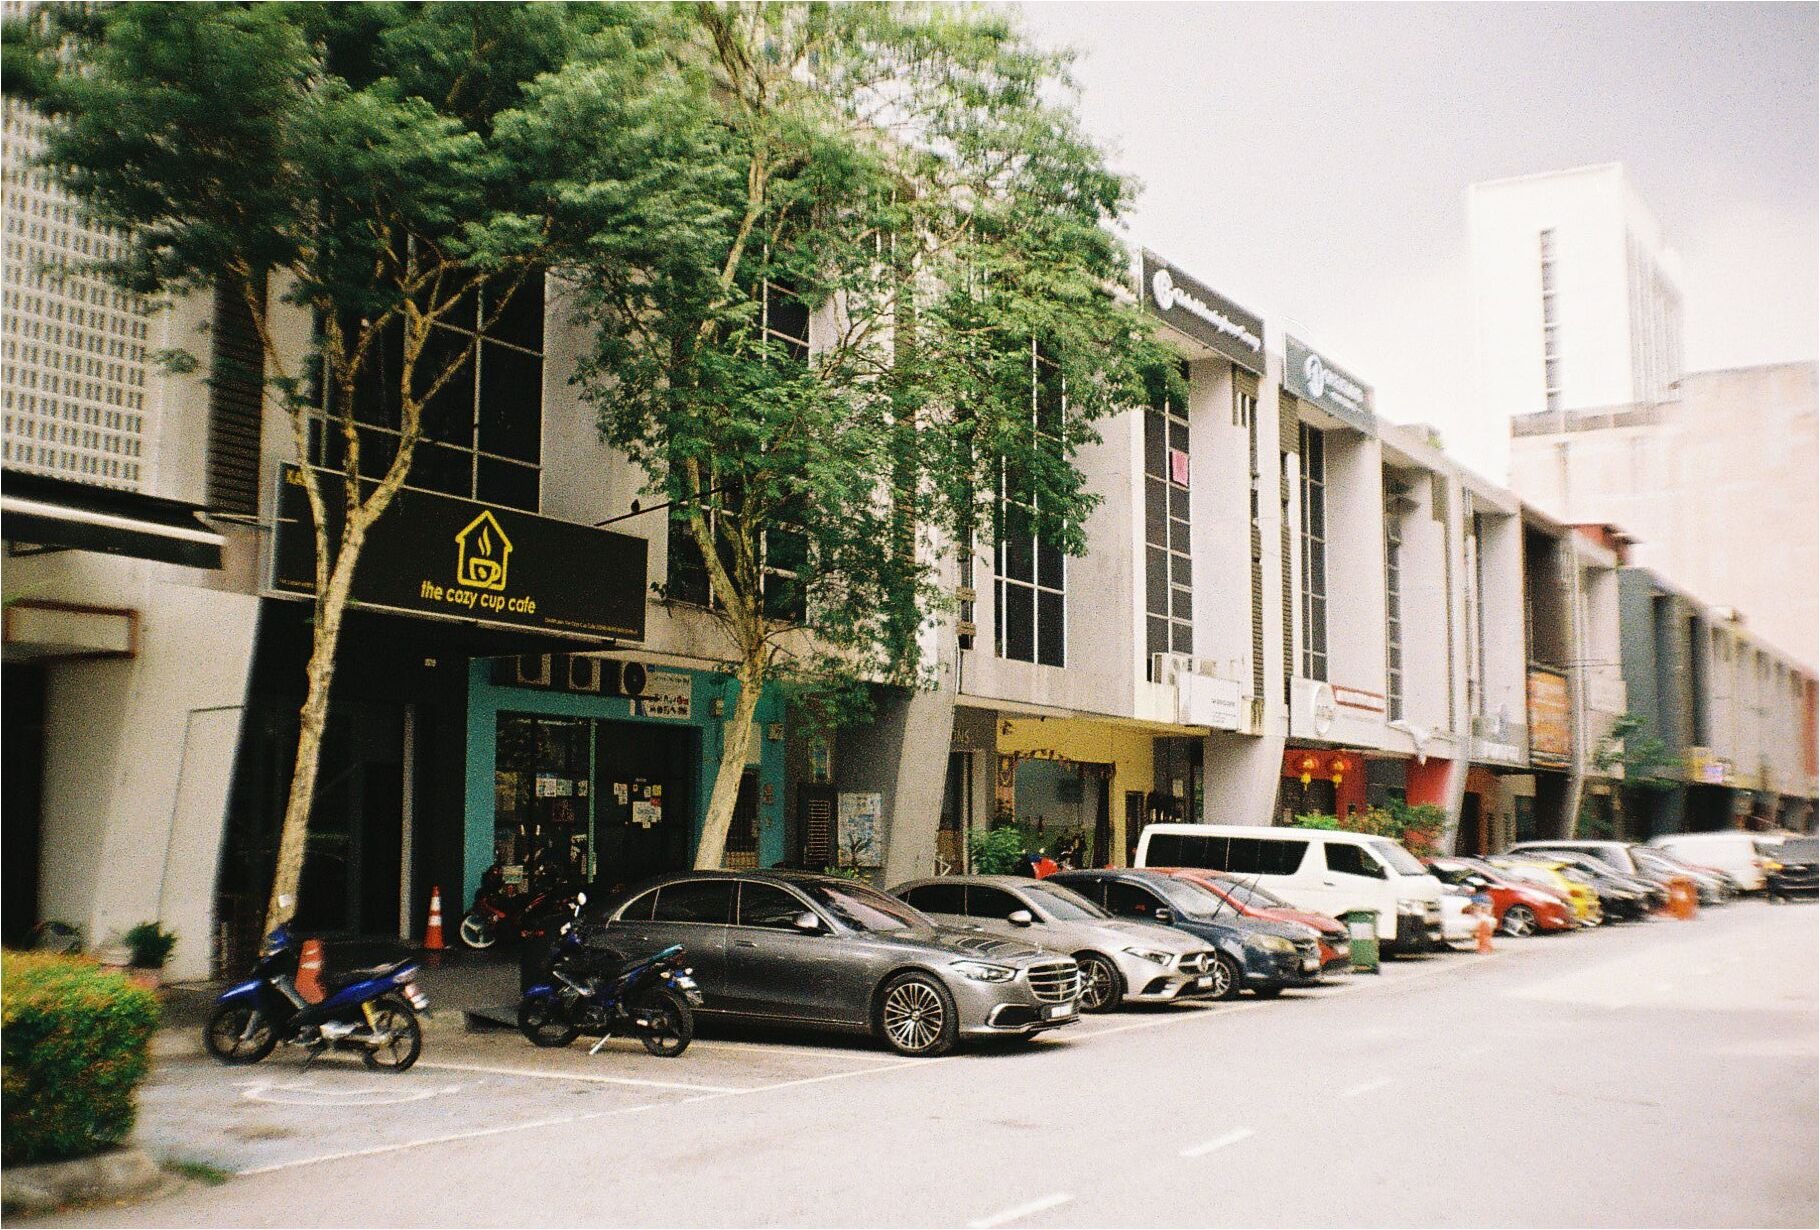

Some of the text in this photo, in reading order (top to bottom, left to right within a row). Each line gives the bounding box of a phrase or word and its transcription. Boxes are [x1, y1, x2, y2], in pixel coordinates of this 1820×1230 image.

[420, 580, 536, 614] the cozy cup cafe
